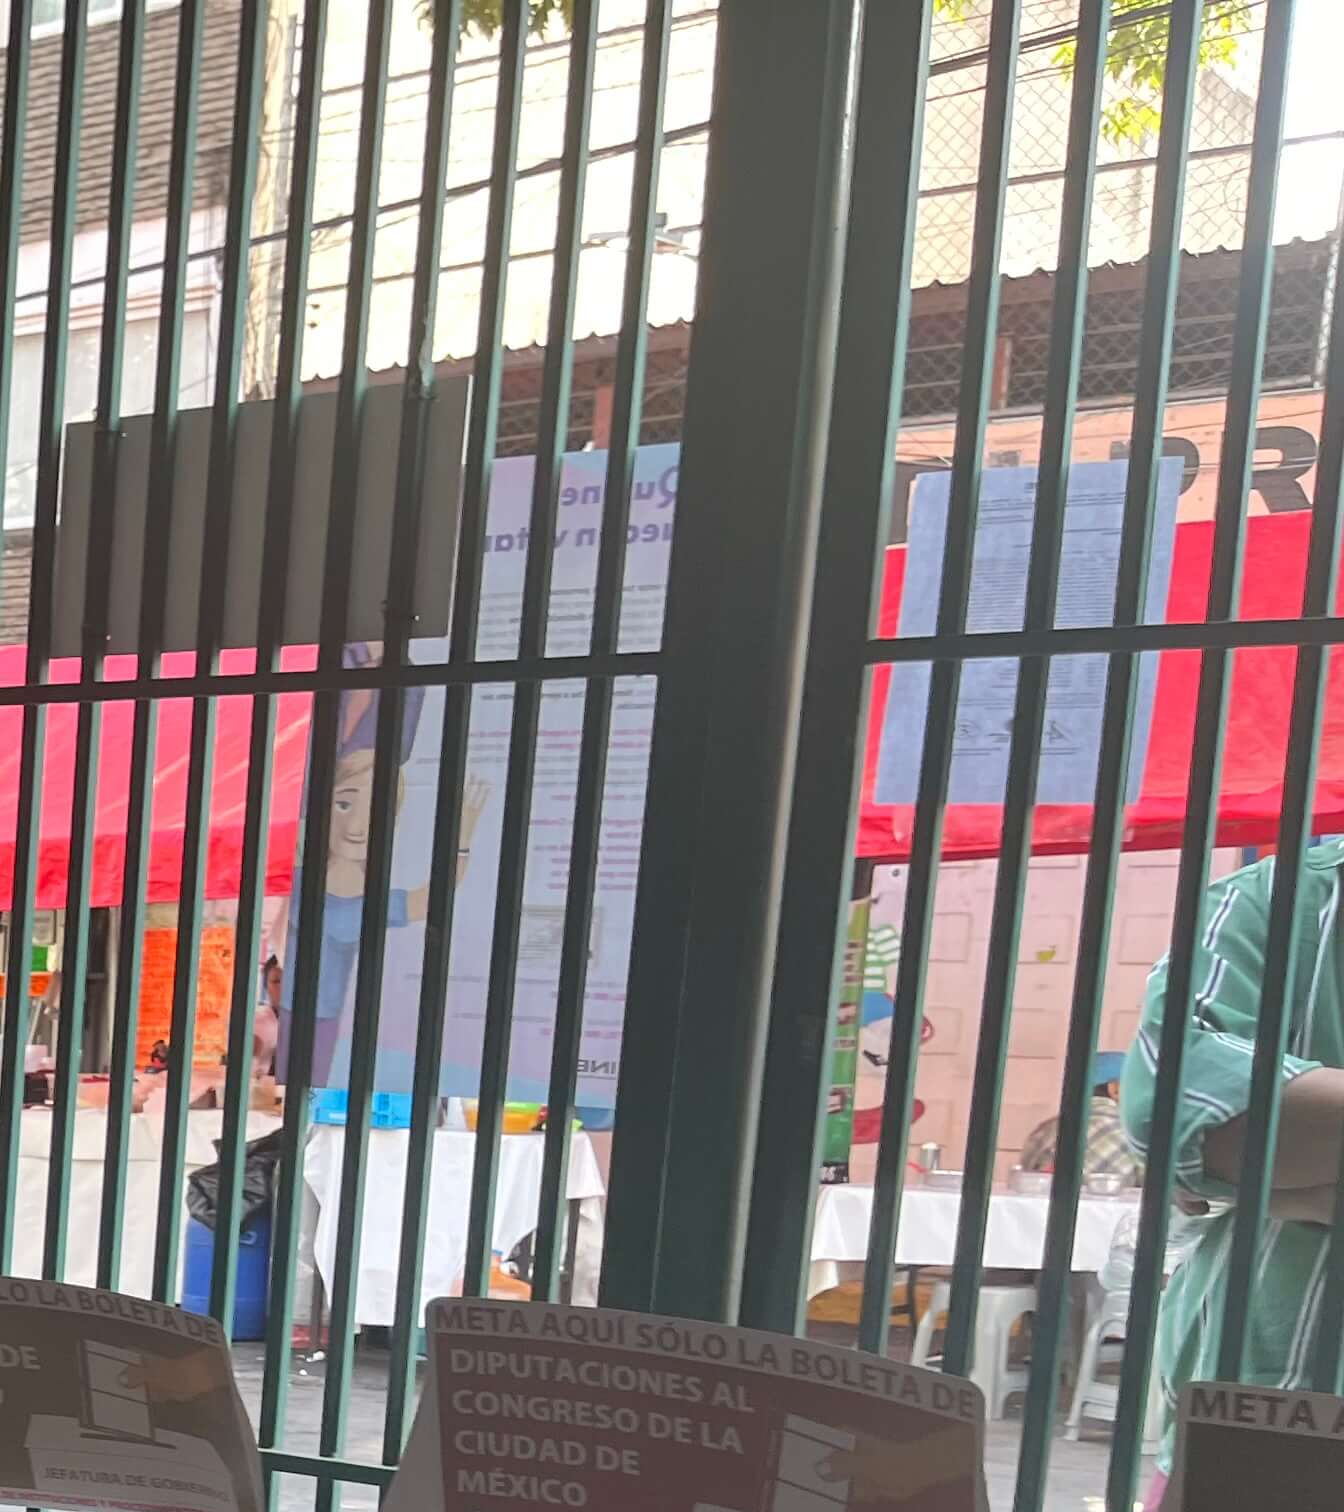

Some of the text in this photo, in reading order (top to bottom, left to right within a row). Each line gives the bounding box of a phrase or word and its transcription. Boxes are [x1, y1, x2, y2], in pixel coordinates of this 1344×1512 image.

[42, 1285, 73, 1310] LA
[78, 1291, 180, 1332] BOLETA
[187, 1312, 219, 1342] DE
[434, 1304, 978, 1421] META AQUÍ SÓLO LA BOLETA DE
[450, 1347, 756, 1414] DIPUTACIONES AL
[453, 1389, 745, 1456] CONGRESO DE LA
[1190, 1387, 1317, 1431] META
[454, 1429, 641, 1476] CIUDAD DE
[457, 1461, 589, 1508] MÉXICO
